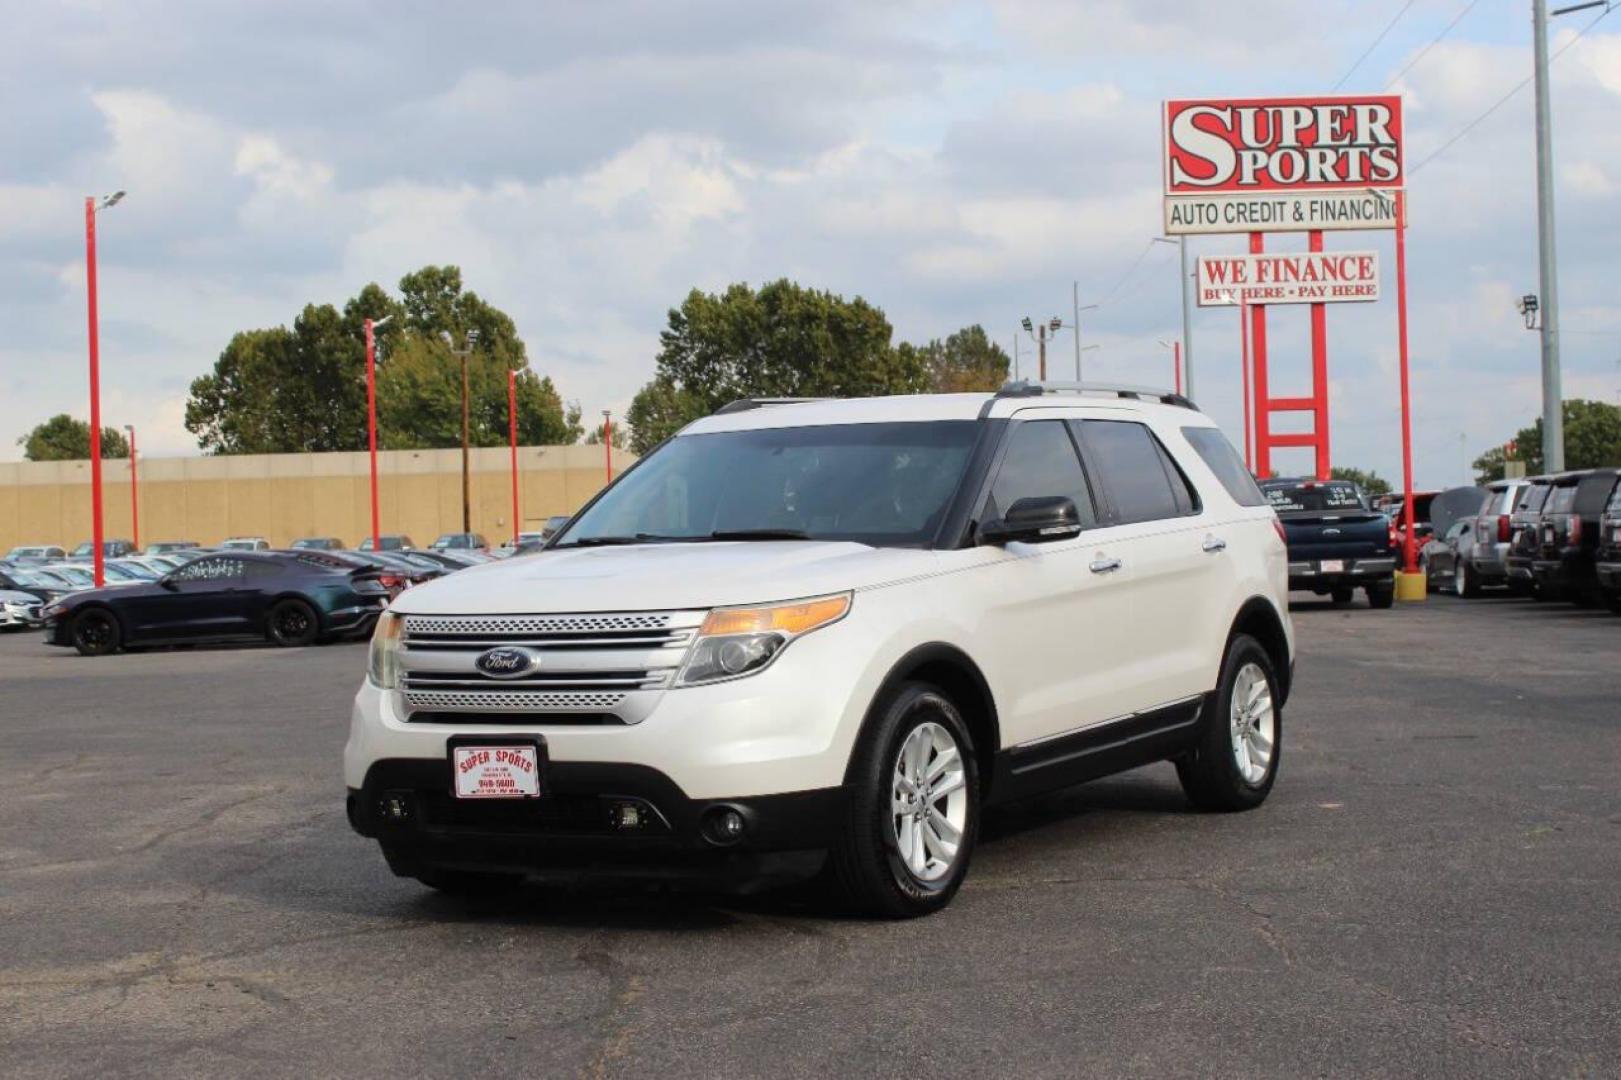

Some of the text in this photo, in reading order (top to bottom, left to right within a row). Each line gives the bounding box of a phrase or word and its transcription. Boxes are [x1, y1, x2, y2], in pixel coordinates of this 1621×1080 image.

[1172, 104, 1396, 187] SUPER
[1170, 203, 1218, 225] AUTO
[1224, 201, 1287, 224] CREDIT
[1292, 201, 1304, 222] &
[1204, 256, 1375, 284] WE FINANCE
[1241, 287, 1285, 299] HERE
[1298, 286, 1327, 297] PAY
[1332, 284, 1377, 296] HERE
[486, 651, 519, 669] Ford
[460, 750, 533, 773] SUPER SPORTS
